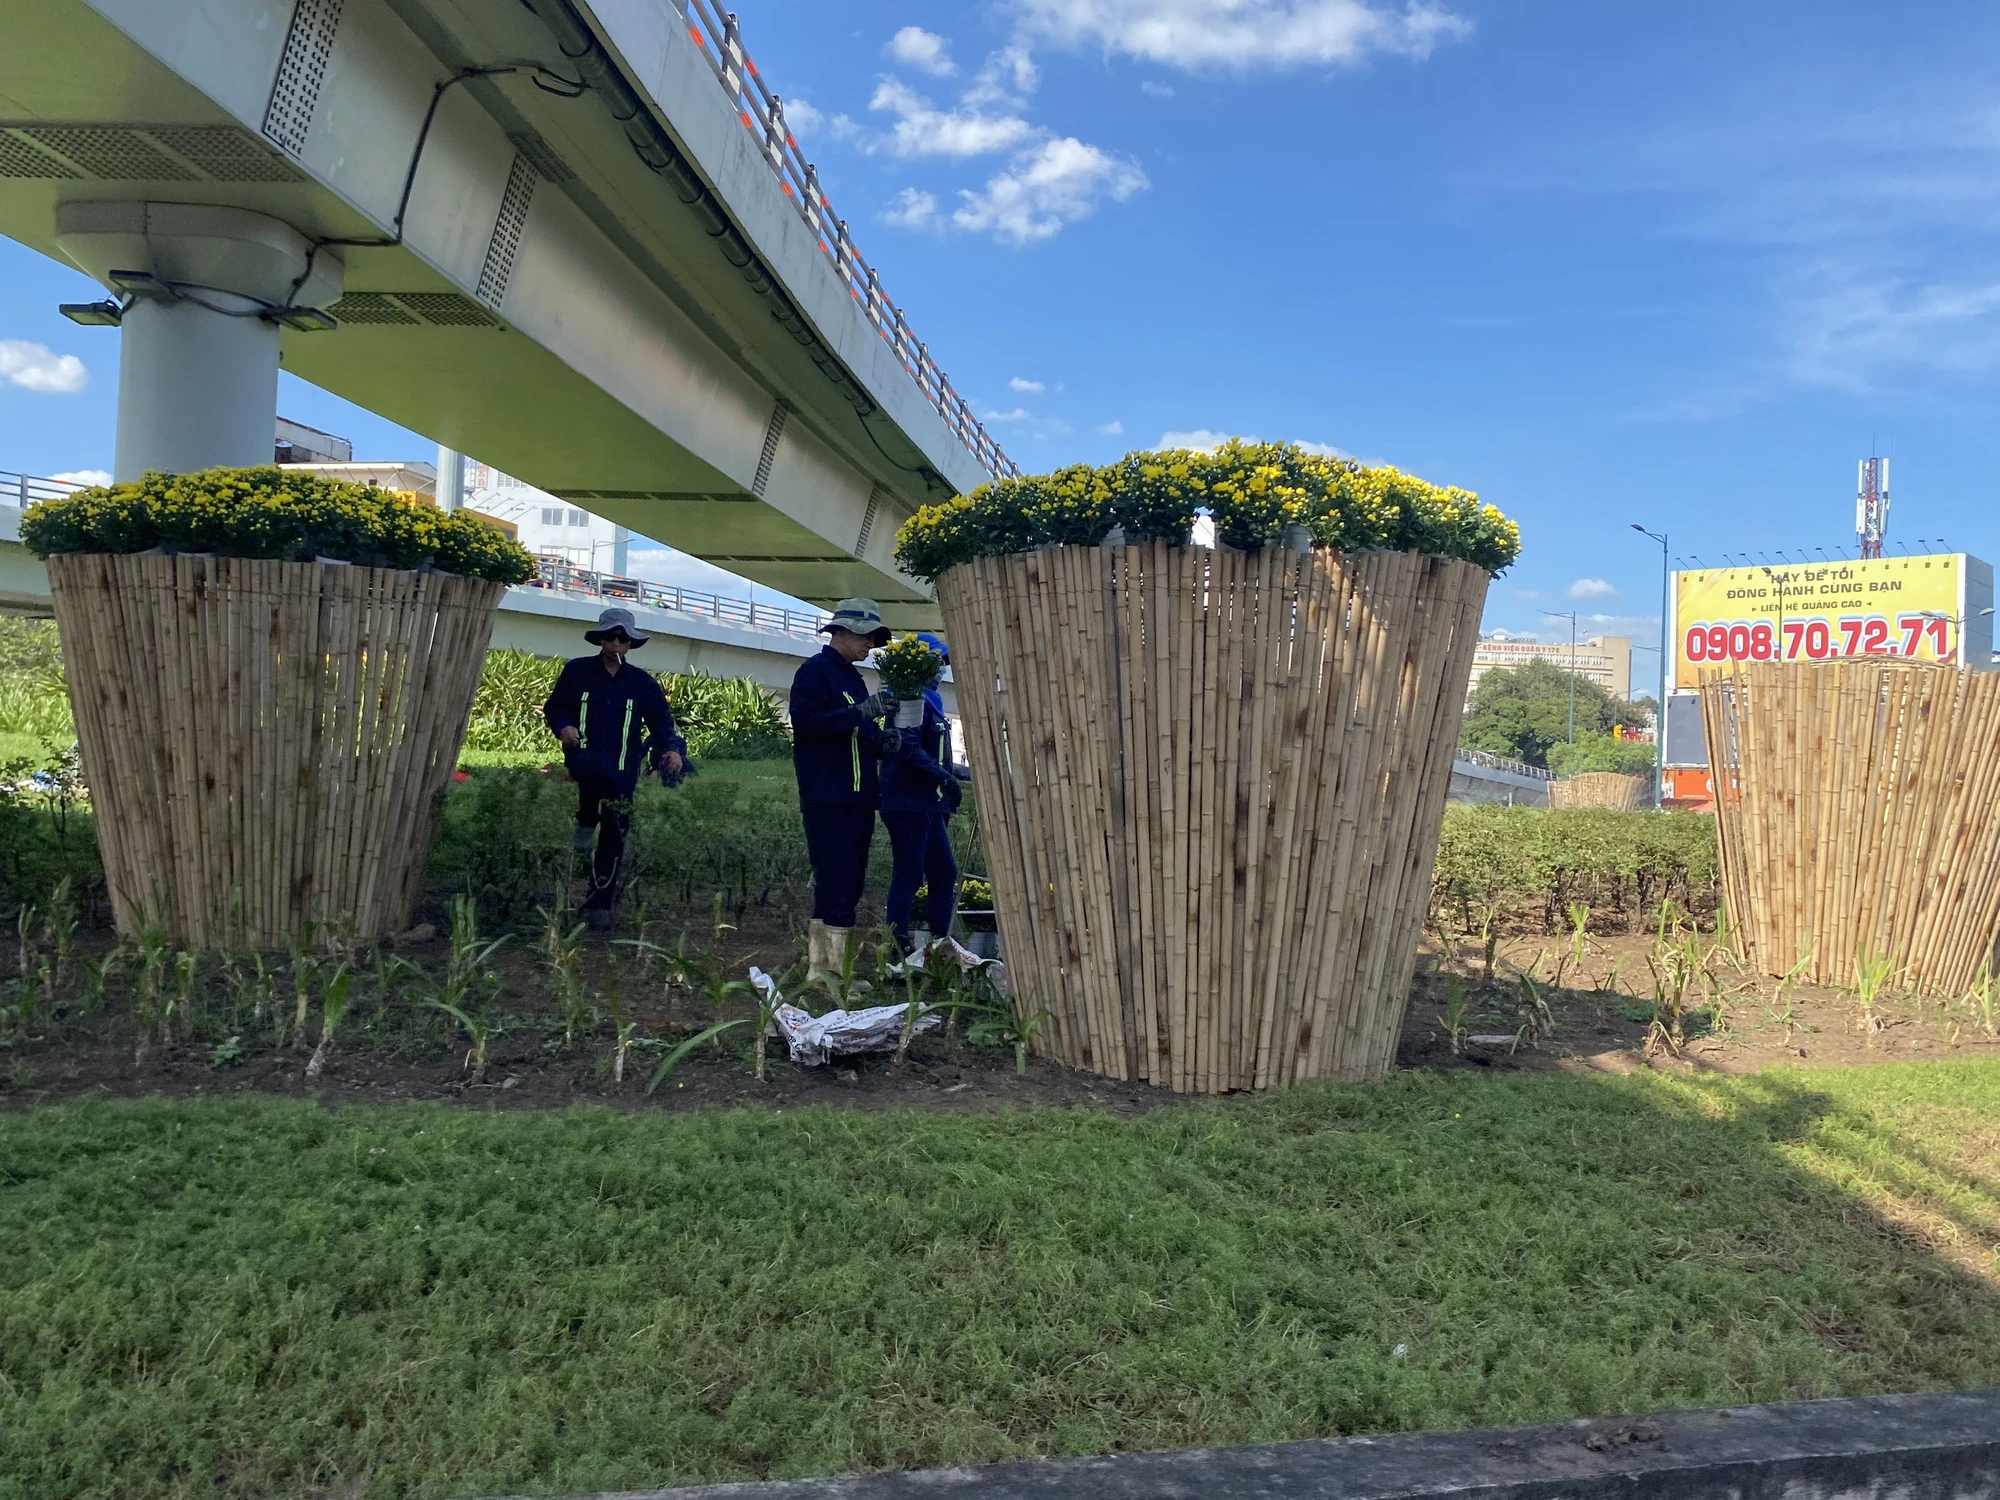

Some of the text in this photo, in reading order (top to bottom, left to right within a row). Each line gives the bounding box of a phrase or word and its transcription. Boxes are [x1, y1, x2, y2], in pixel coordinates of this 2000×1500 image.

[1726, 581, 1902, 599] ĐỒNG HÀNH CÙNG BẠN
[1761, 599, 1862, 612] LIÊN HỆ QUẢNG CÁO
[1686, 617, 1951, 662] 0908.70.72.71
